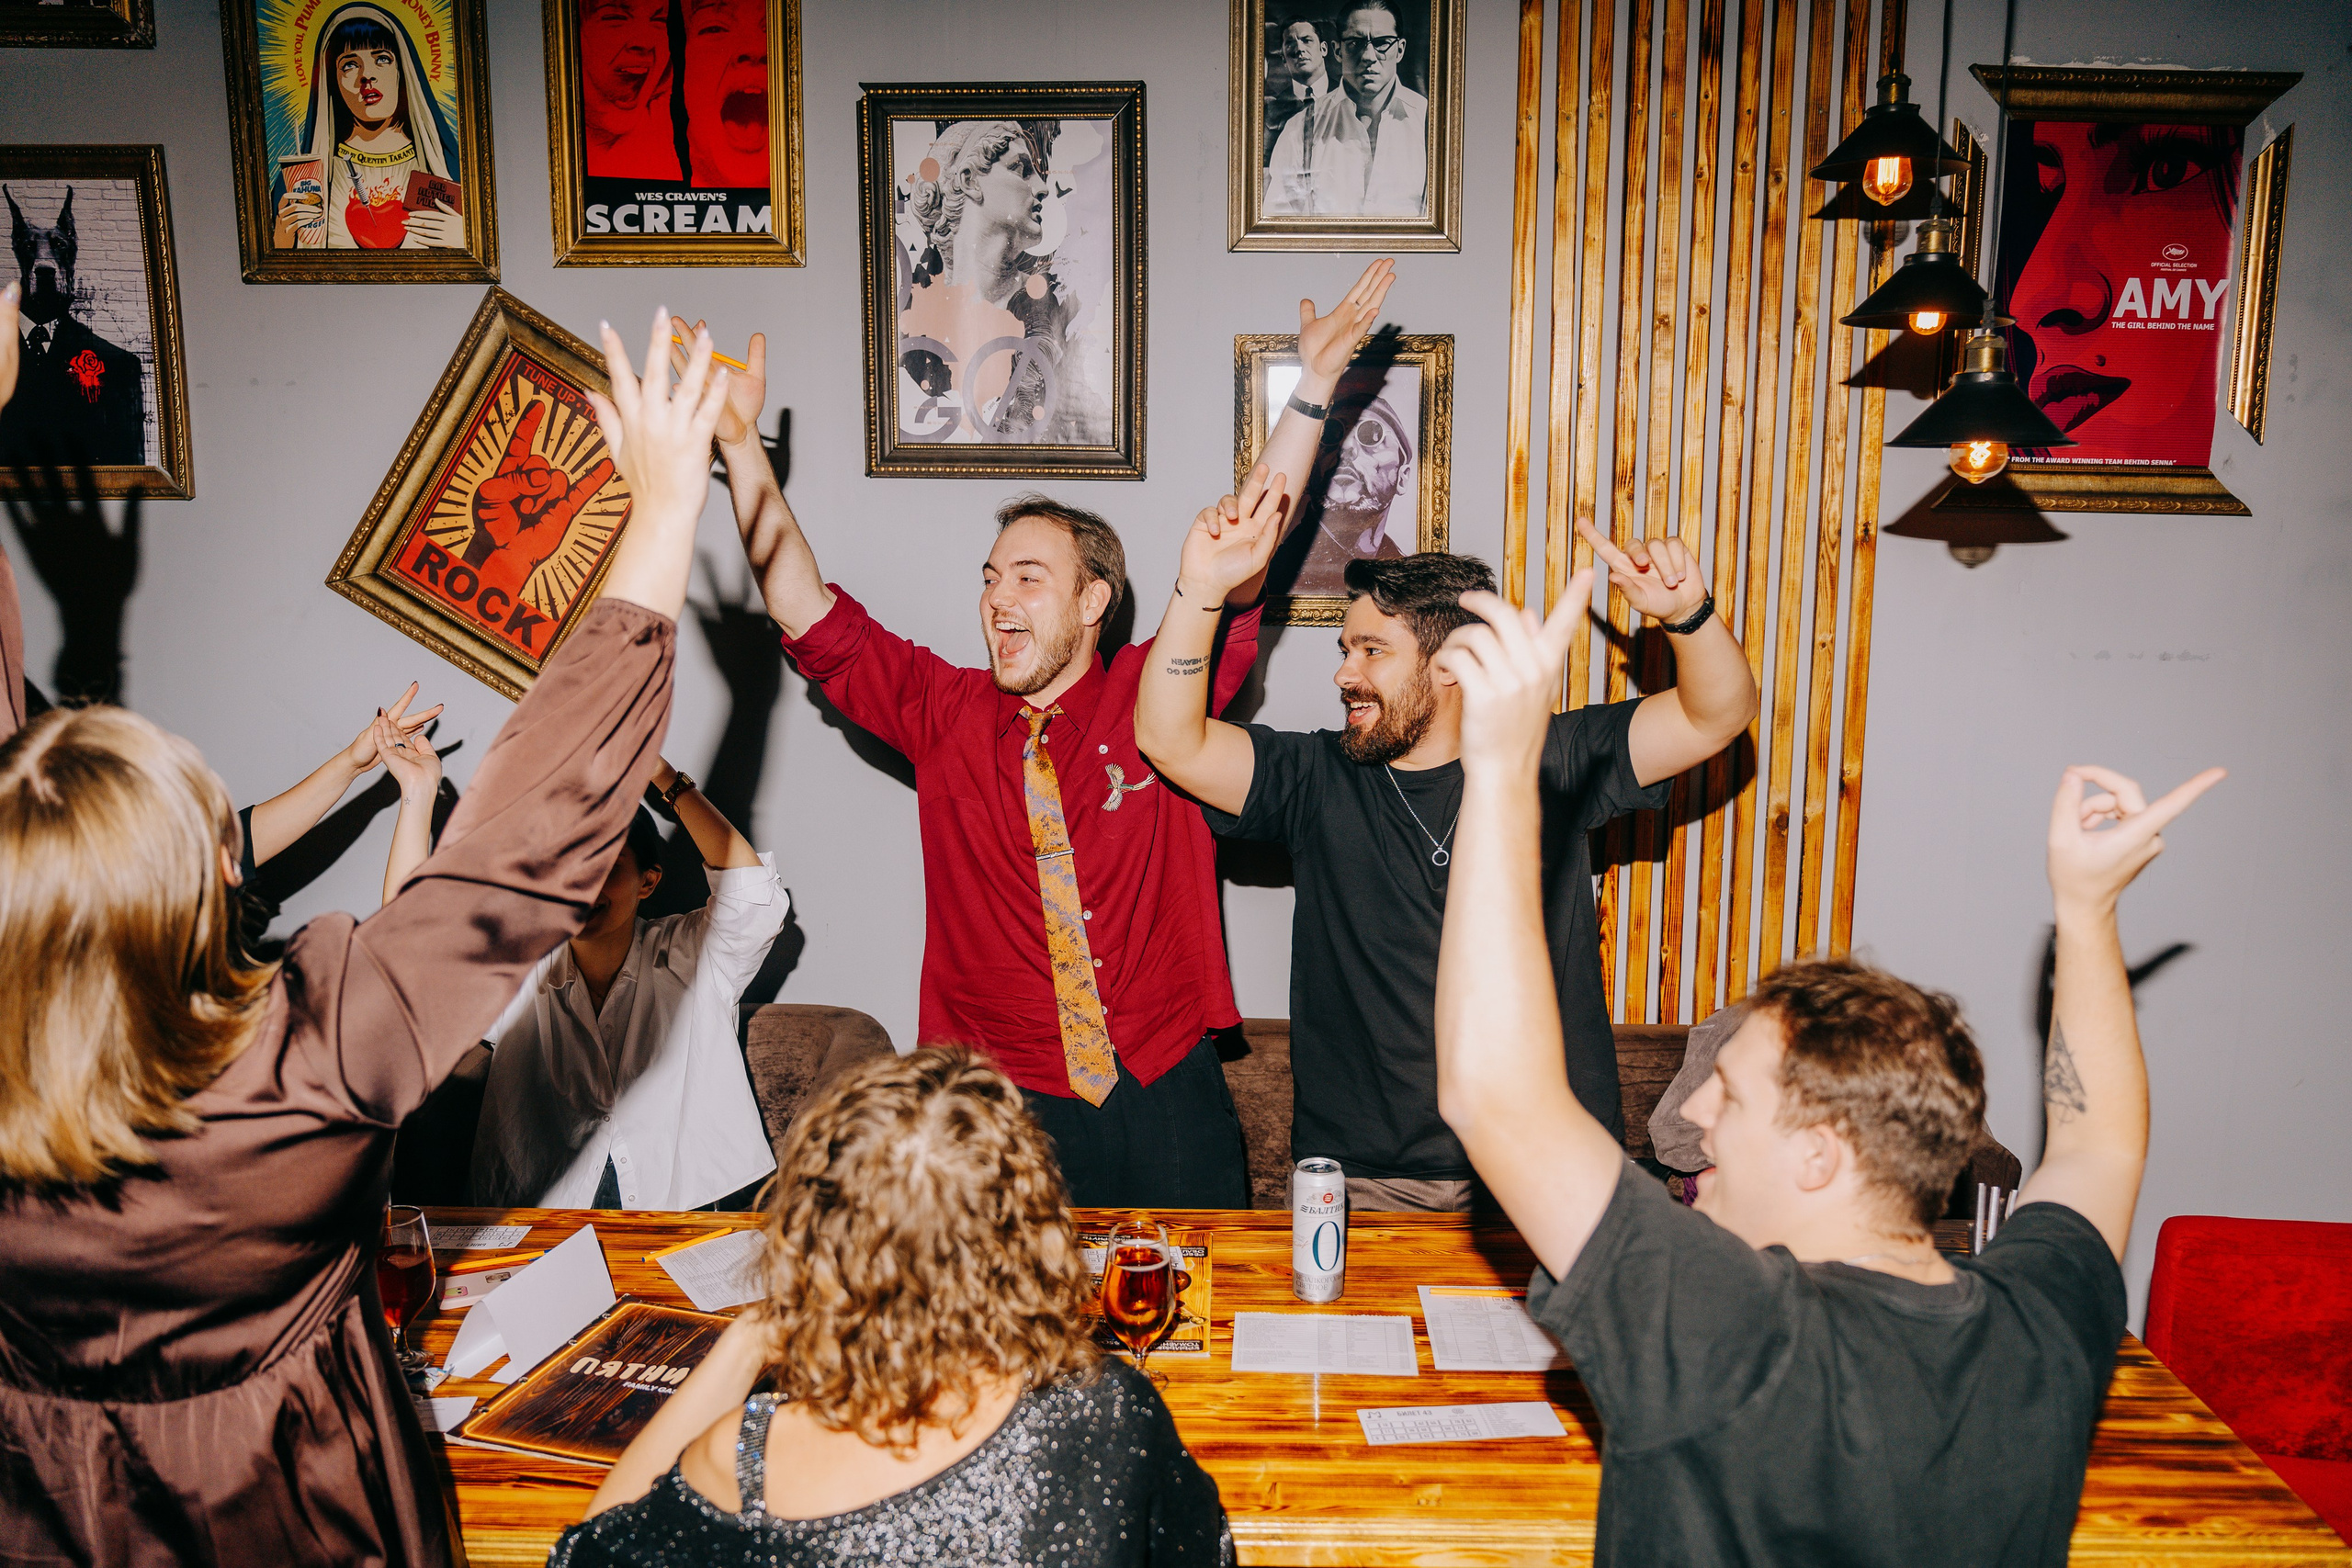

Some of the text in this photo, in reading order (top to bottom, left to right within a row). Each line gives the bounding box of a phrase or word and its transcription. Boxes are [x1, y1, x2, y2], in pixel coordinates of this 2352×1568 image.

[294, 0, 322, 31] PUM
[401, 0, 435, 29] ONEY
[294, 56, 307, 82] LOVE
[356, 152, 387, 164] QUENTIN
[635, 192, 728, 201] WES CRAVEN'S
[585, 204, 771, 233] SCREAM
[2112, 277, 2232, 320] AMY
[523, 364, 599, 423] TUNE UP TU
[411, 541, 548, 649] ROCK
[1312, 1220, 1340, 1272] 0
[570, 1356, 691, 1385] ПЯТНИ
[622, 1382, 659, 1392] FAMILY
